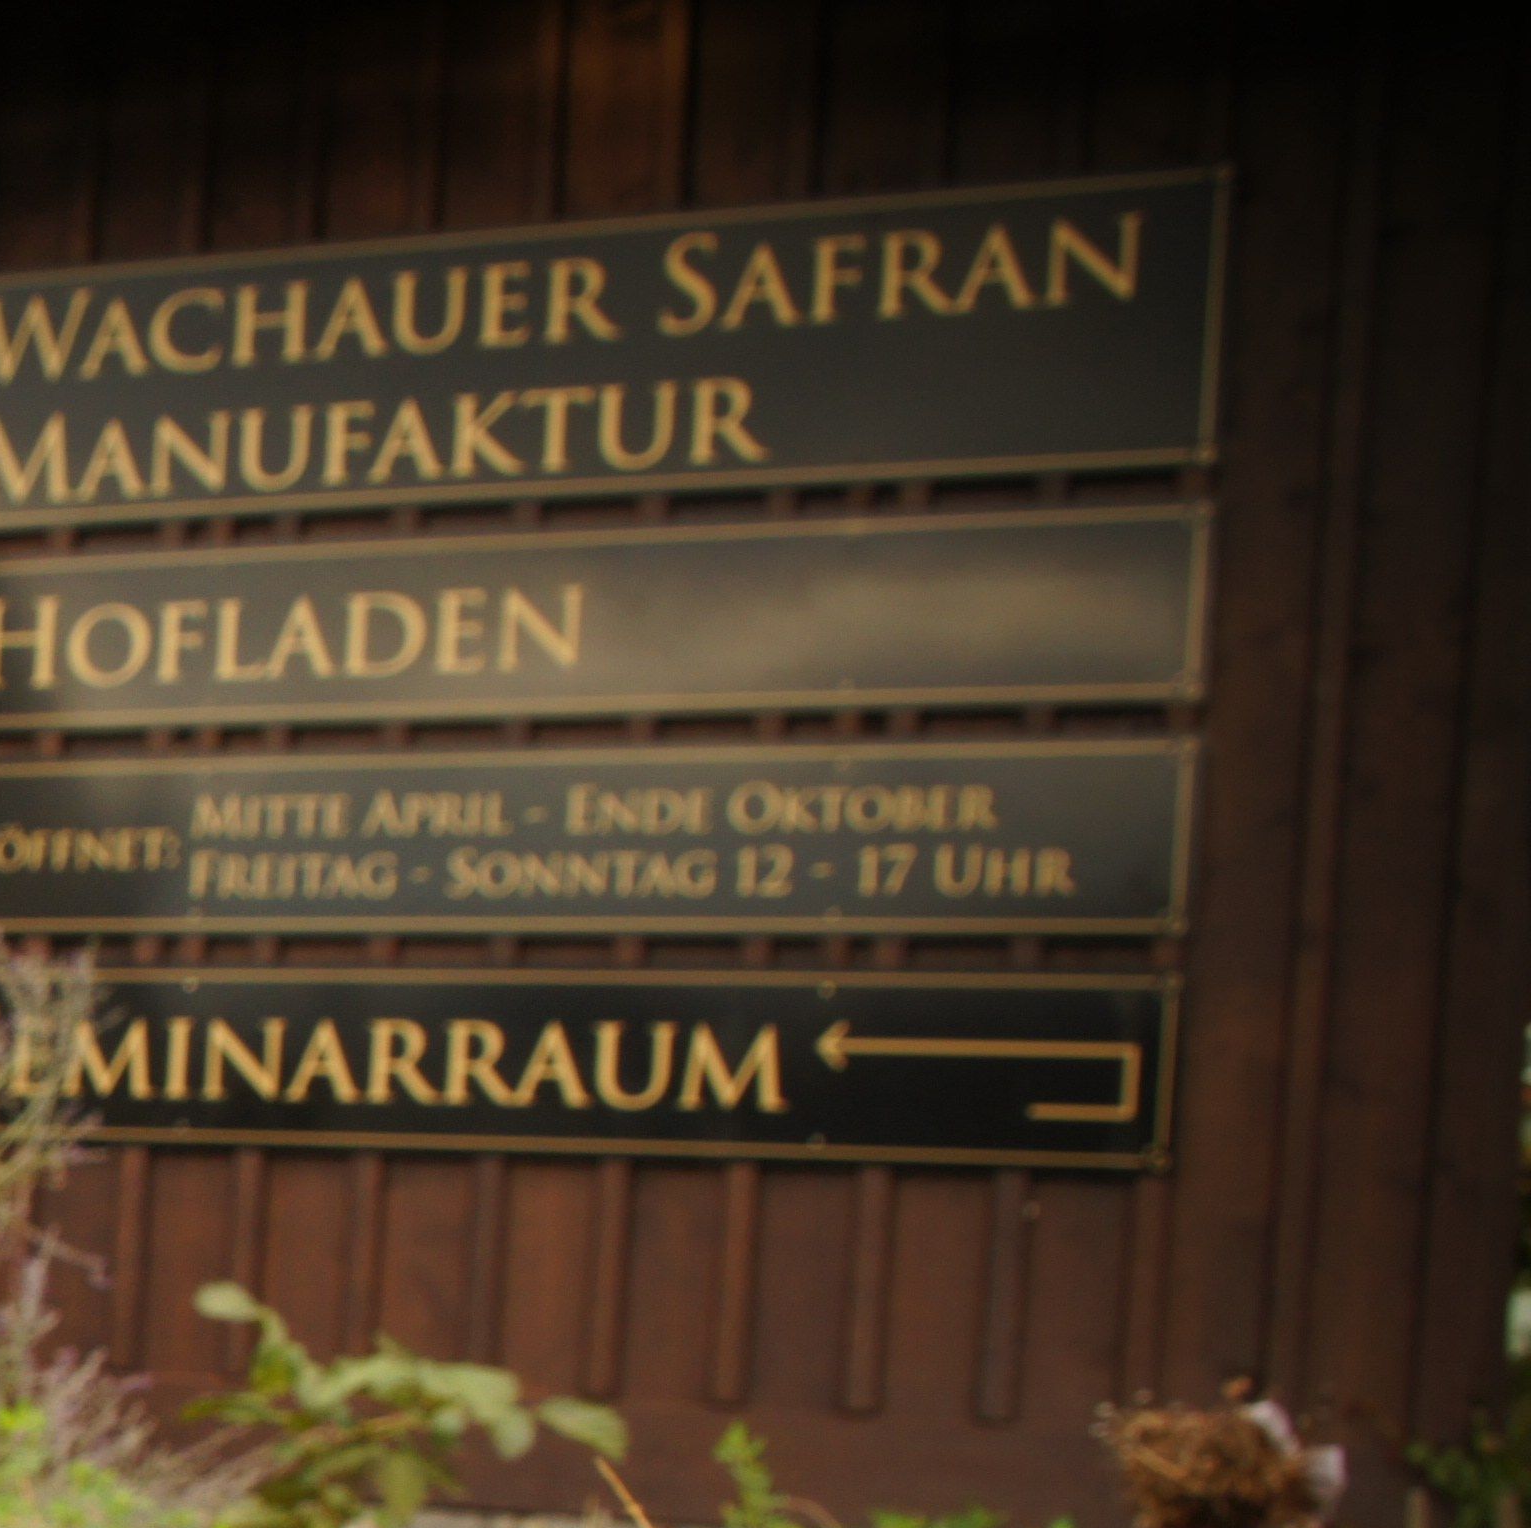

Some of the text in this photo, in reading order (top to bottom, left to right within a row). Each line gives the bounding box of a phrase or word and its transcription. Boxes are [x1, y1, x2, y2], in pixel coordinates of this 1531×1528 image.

[657, 211, 1142, 338] SAFRAN
[190, 791, 350, 839] MITTE
[361, 789, 514, 838] APRIL
[564, 782, 713, 838] ENDE
[726, 780, 998, 835] OKTOBER
[187, 849, 400, 900] FREITAG
[445, 845, 718, 900] SONNTAG
[735, 843, 794, 899] 12
[858, 842, 918, 897] 17
[934, 844, 1077, 897] UHR
